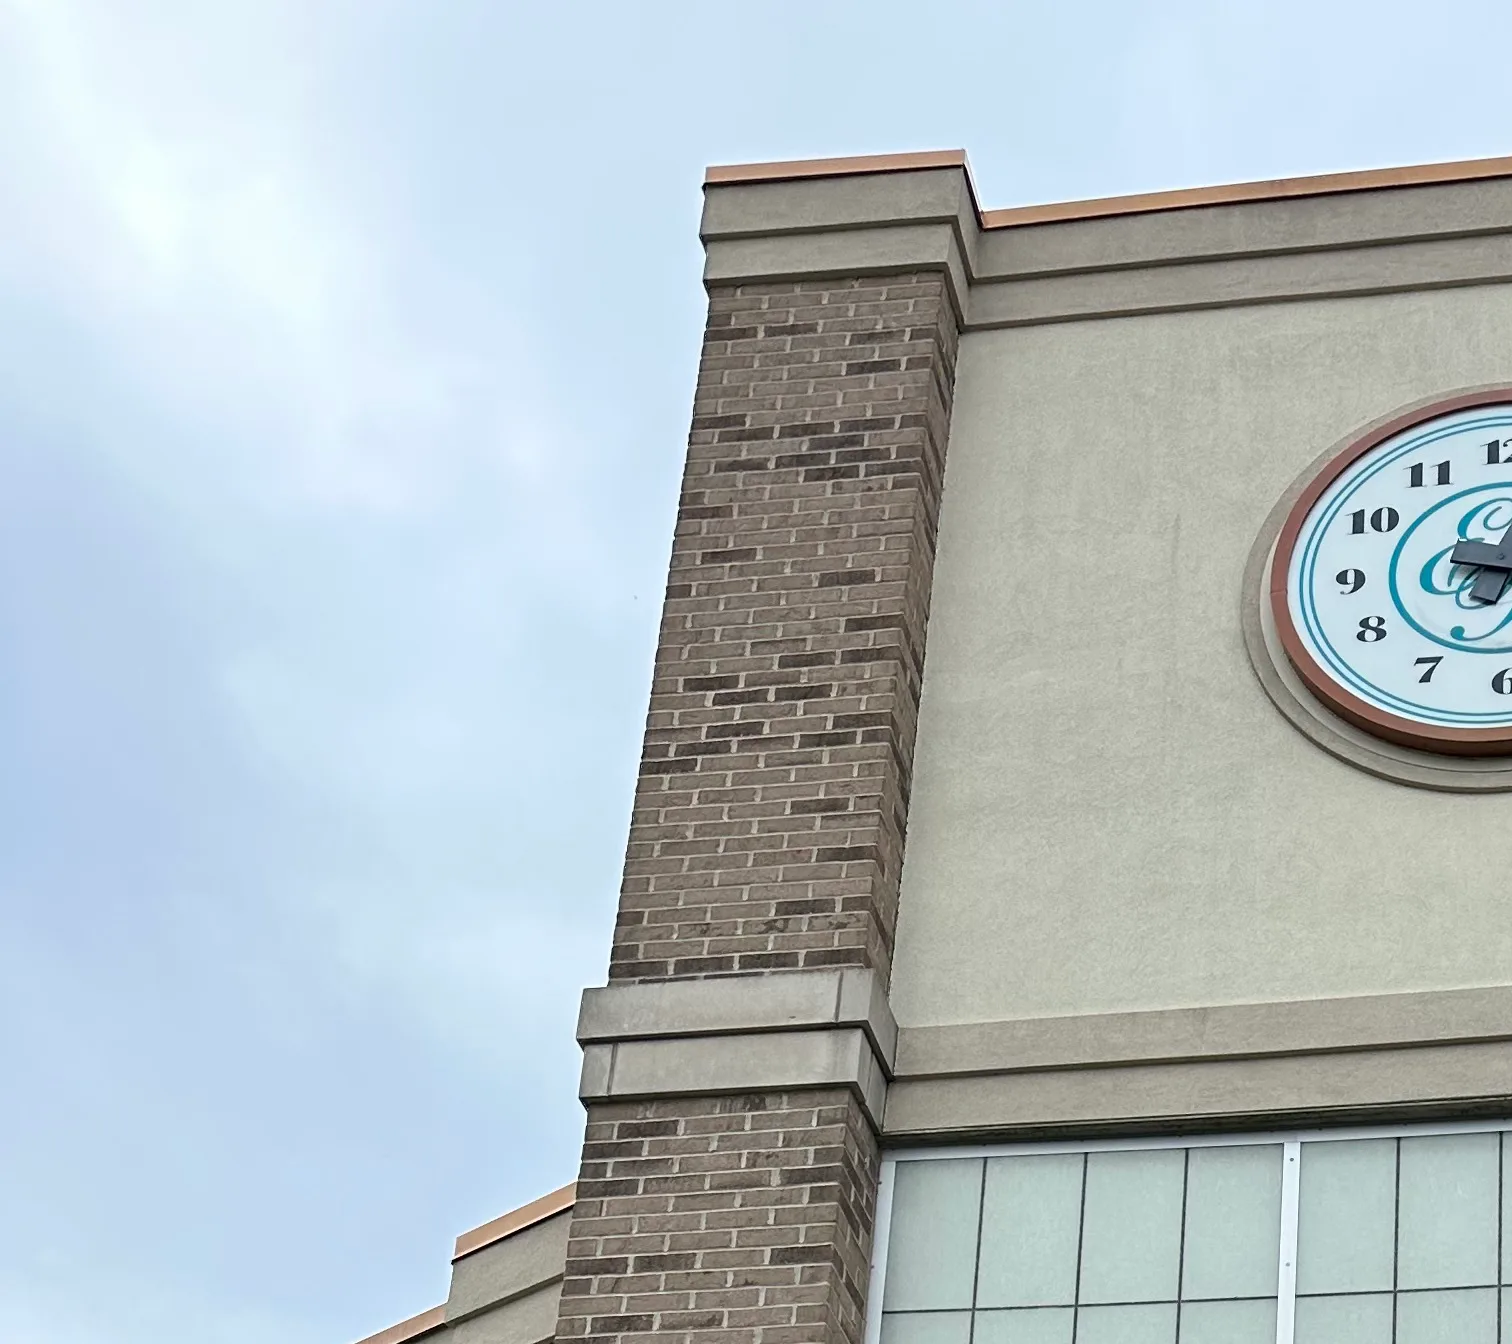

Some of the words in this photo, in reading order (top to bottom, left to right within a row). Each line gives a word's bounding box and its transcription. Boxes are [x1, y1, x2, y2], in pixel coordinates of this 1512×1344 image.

[1403, 460, 1453, 488] 11
[1346, 506, 1399, 535] 10
[1336, 568, 1366, 594] 9
[1356, 615, 1387, 642] 8
[1414, 656, 1443, 683] 7
